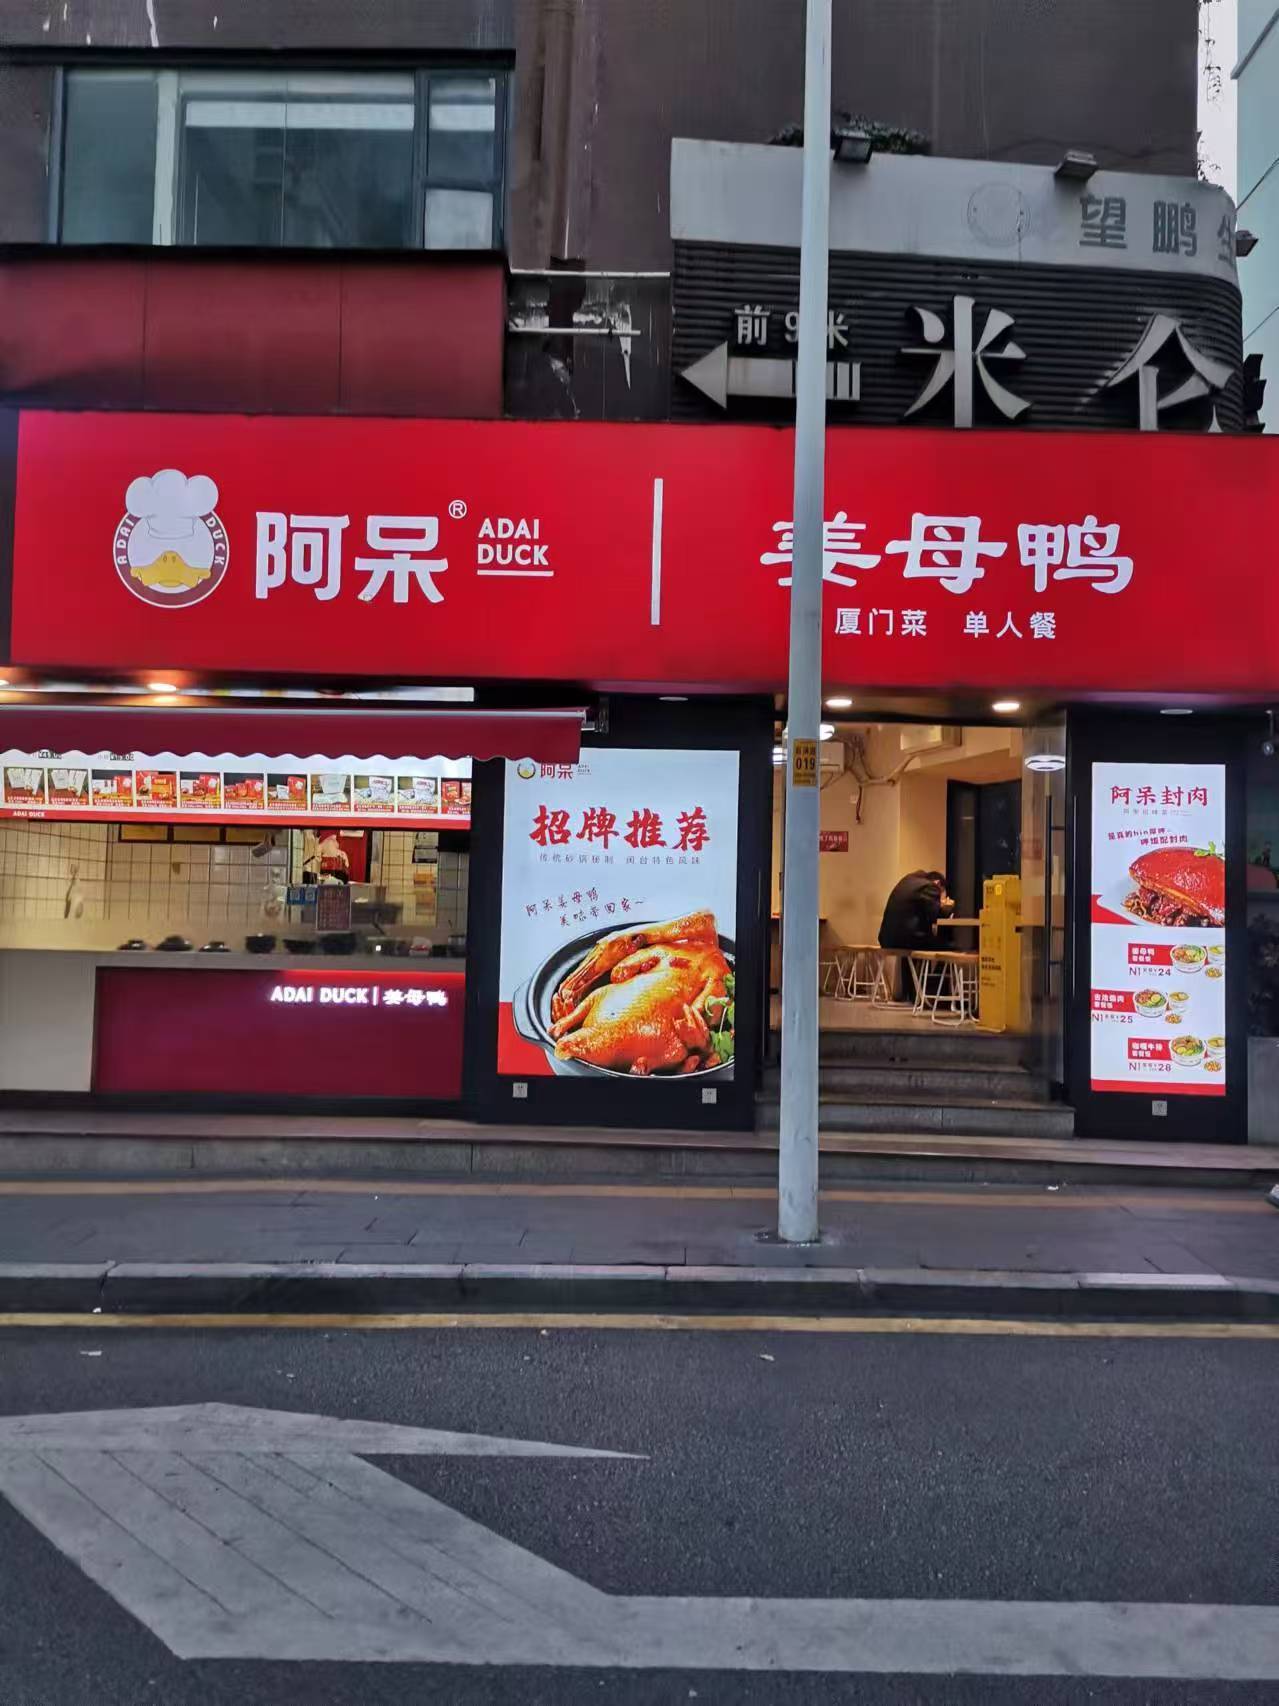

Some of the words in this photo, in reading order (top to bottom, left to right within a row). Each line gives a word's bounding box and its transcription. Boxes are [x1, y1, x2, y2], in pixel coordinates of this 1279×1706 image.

[477, 517, 541, 540] ADAI
[205, 516, 226, 566] DUCK
[255, 511, 449, 604] 阿呆
[477, 543, 549, 566] DUCK
[760, 511, 1134, 595] 姜母鸭
[834, 608, 927, 637] 厦门菜
[963, 611, 1057, 640] 单人餐
[796, 756, 816, 770] 019
[1110, 785, 1208, 806] 阿呆封肉
[529, 804, 711, 851] 招牌推荐
[1158, 968, 1171, 977] 24
[270, 985, 313, 1003] ADAI
[319, 987, 369, 1004] DUCK
[1120, 1015, 1133, 1023] 25
